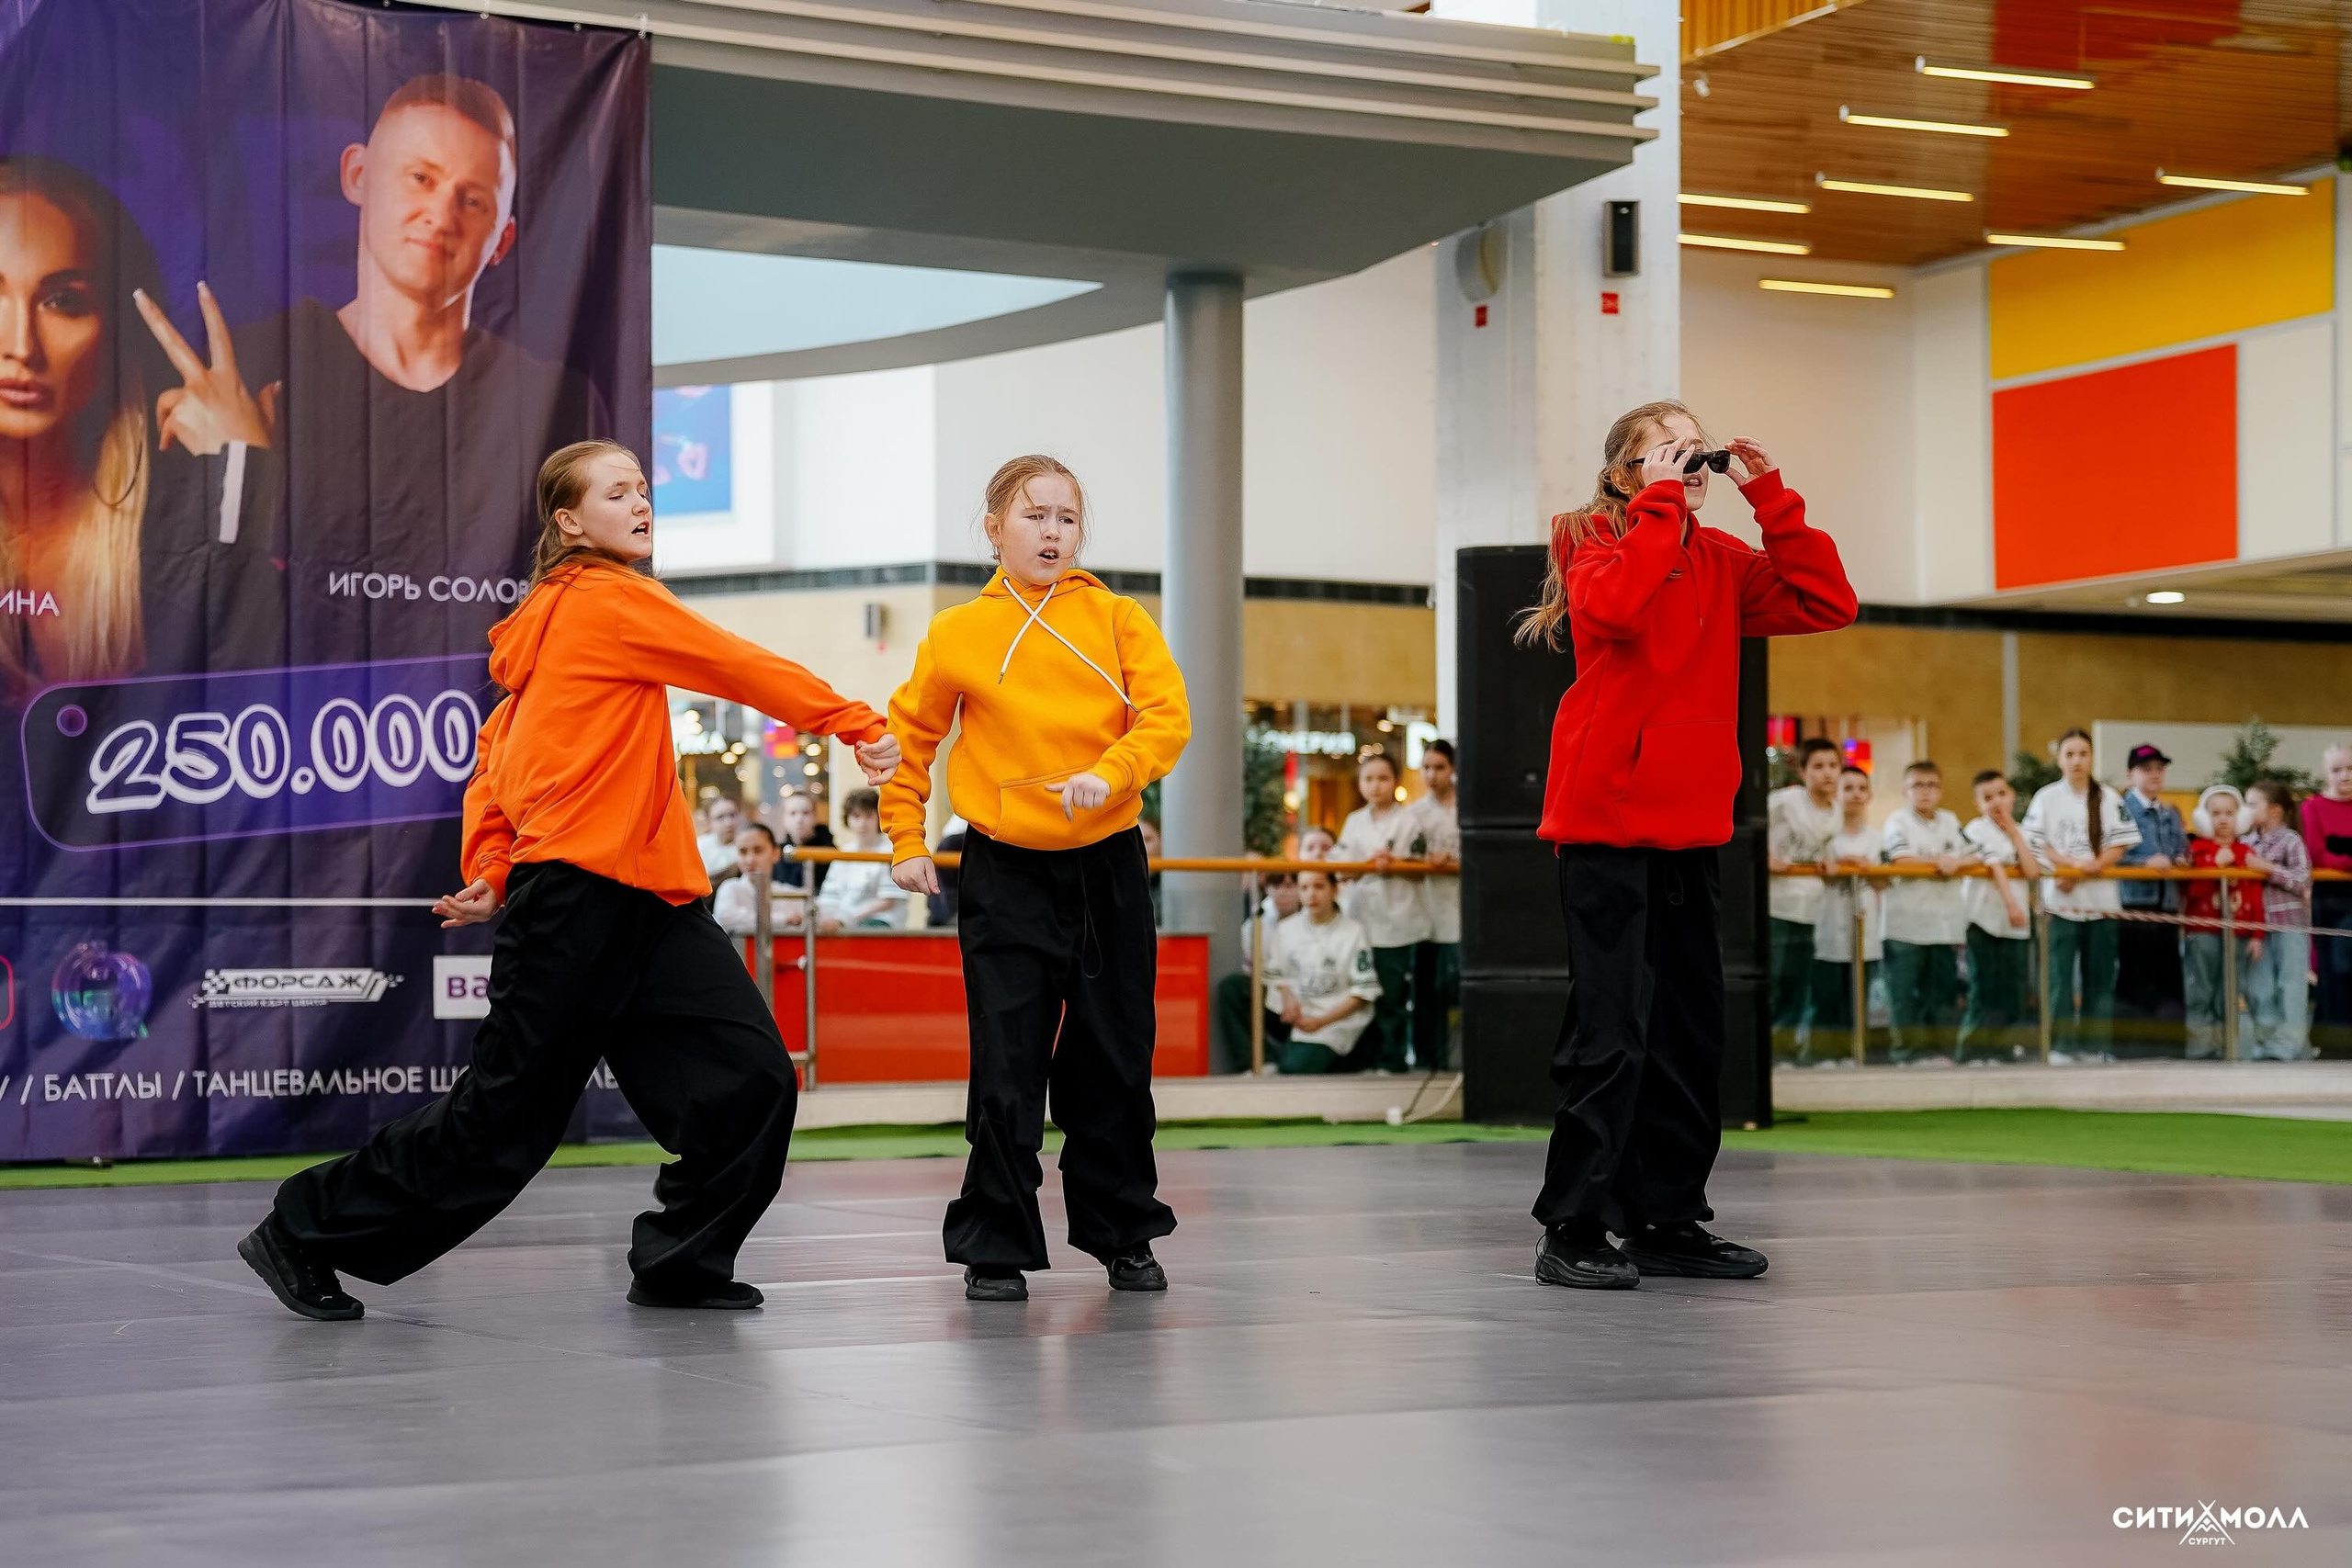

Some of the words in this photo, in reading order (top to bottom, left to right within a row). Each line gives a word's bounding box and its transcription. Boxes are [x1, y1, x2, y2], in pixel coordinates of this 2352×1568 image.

[329, 570, 422, 600] ИГОРЬ
[86, 689, 481, 814] 250.000
[234, 976, 362, 990] ФОРСАЖ
[45, 1071, 162, 1102] БАТТЛЫ
[192, 1066, 424, 1099] ТАНЦЕВАЛЬНОЕ
